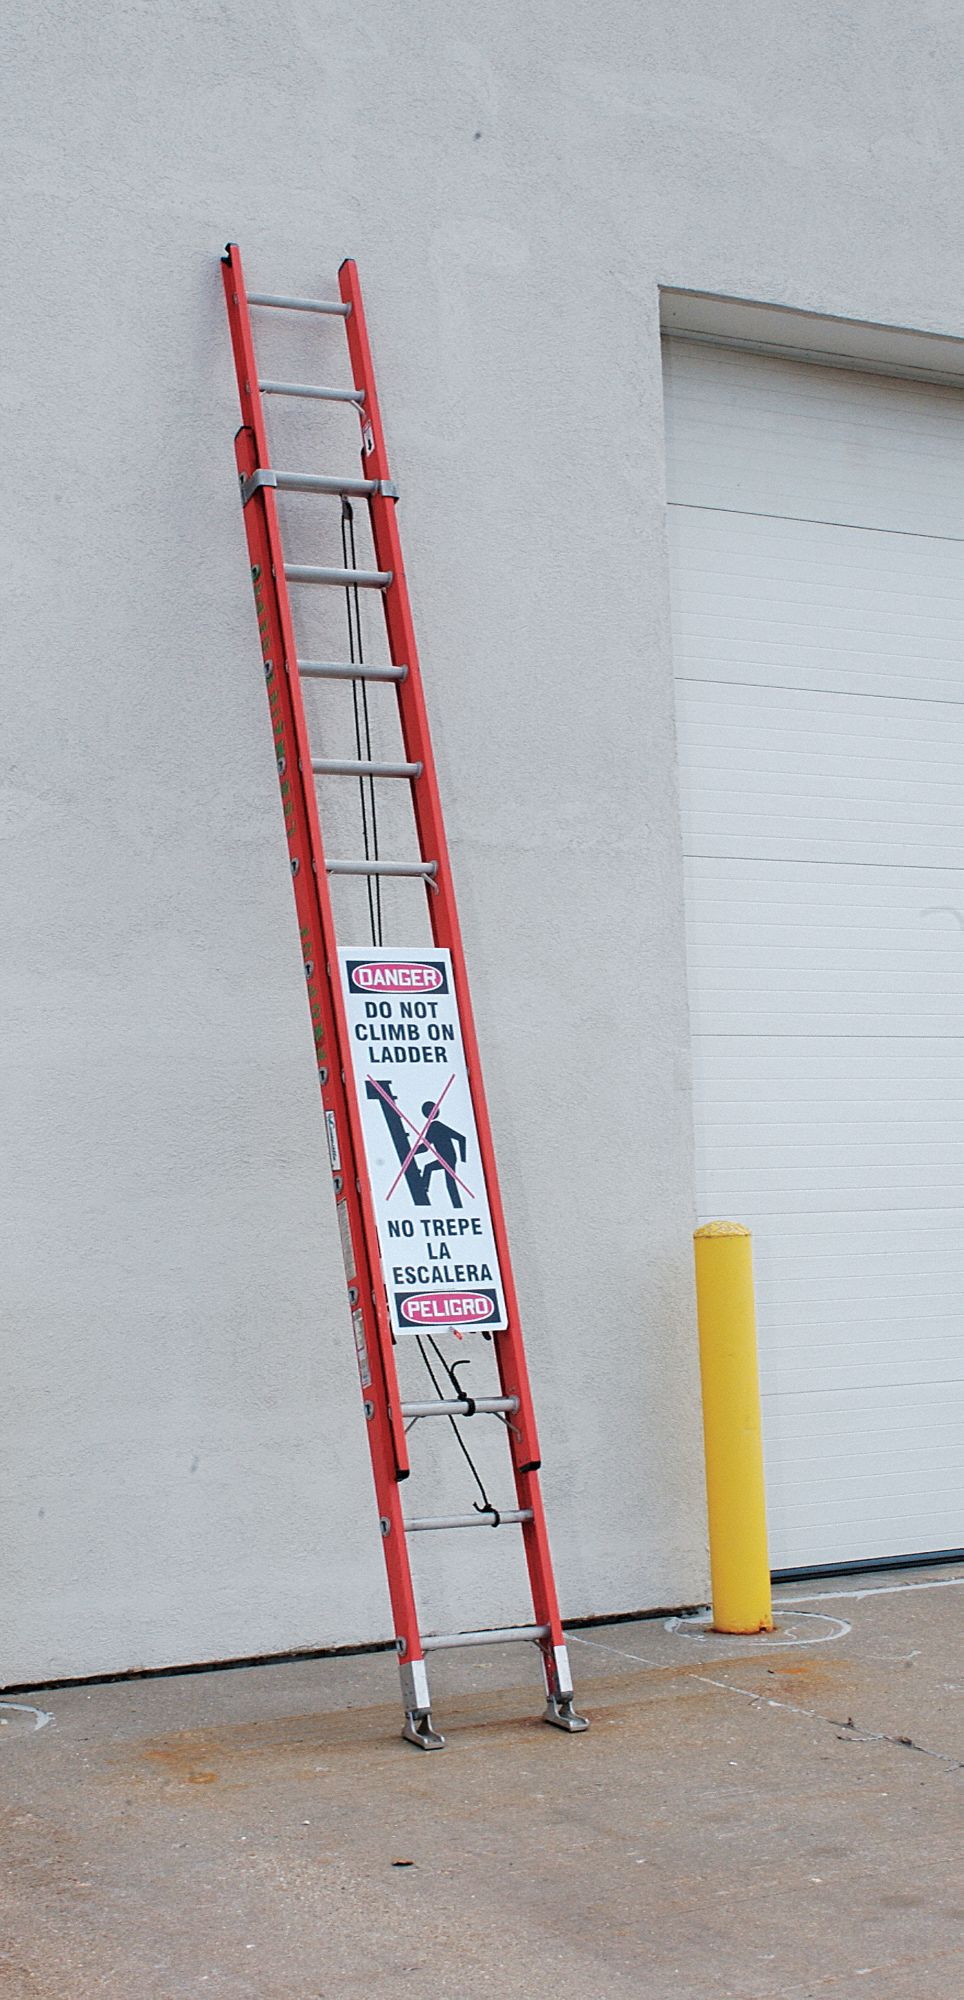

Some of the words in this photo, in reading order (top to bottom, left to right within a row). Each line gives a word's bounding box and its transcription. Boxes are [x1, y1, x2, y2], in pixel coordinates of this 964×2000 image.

[358, 968, 438, 987] DANGER
[365, 1001, 392, 1019] DO
[400, 1001, 438, 1019] NOT
[355, 1024, 420, 1041] CLIMB
[427, 1024, 455, 1041] ON
[369, 1046, 448, 1063] LADDER
[387, 1219, 414, 1238] NO
[420, 1218, 483, 1237] TREPE
[427, 1242, 451, 1260] LA
[392, 1264, 493, 1284] ESCALERA
[407, 1298, 489, 1318] PELIGRO
